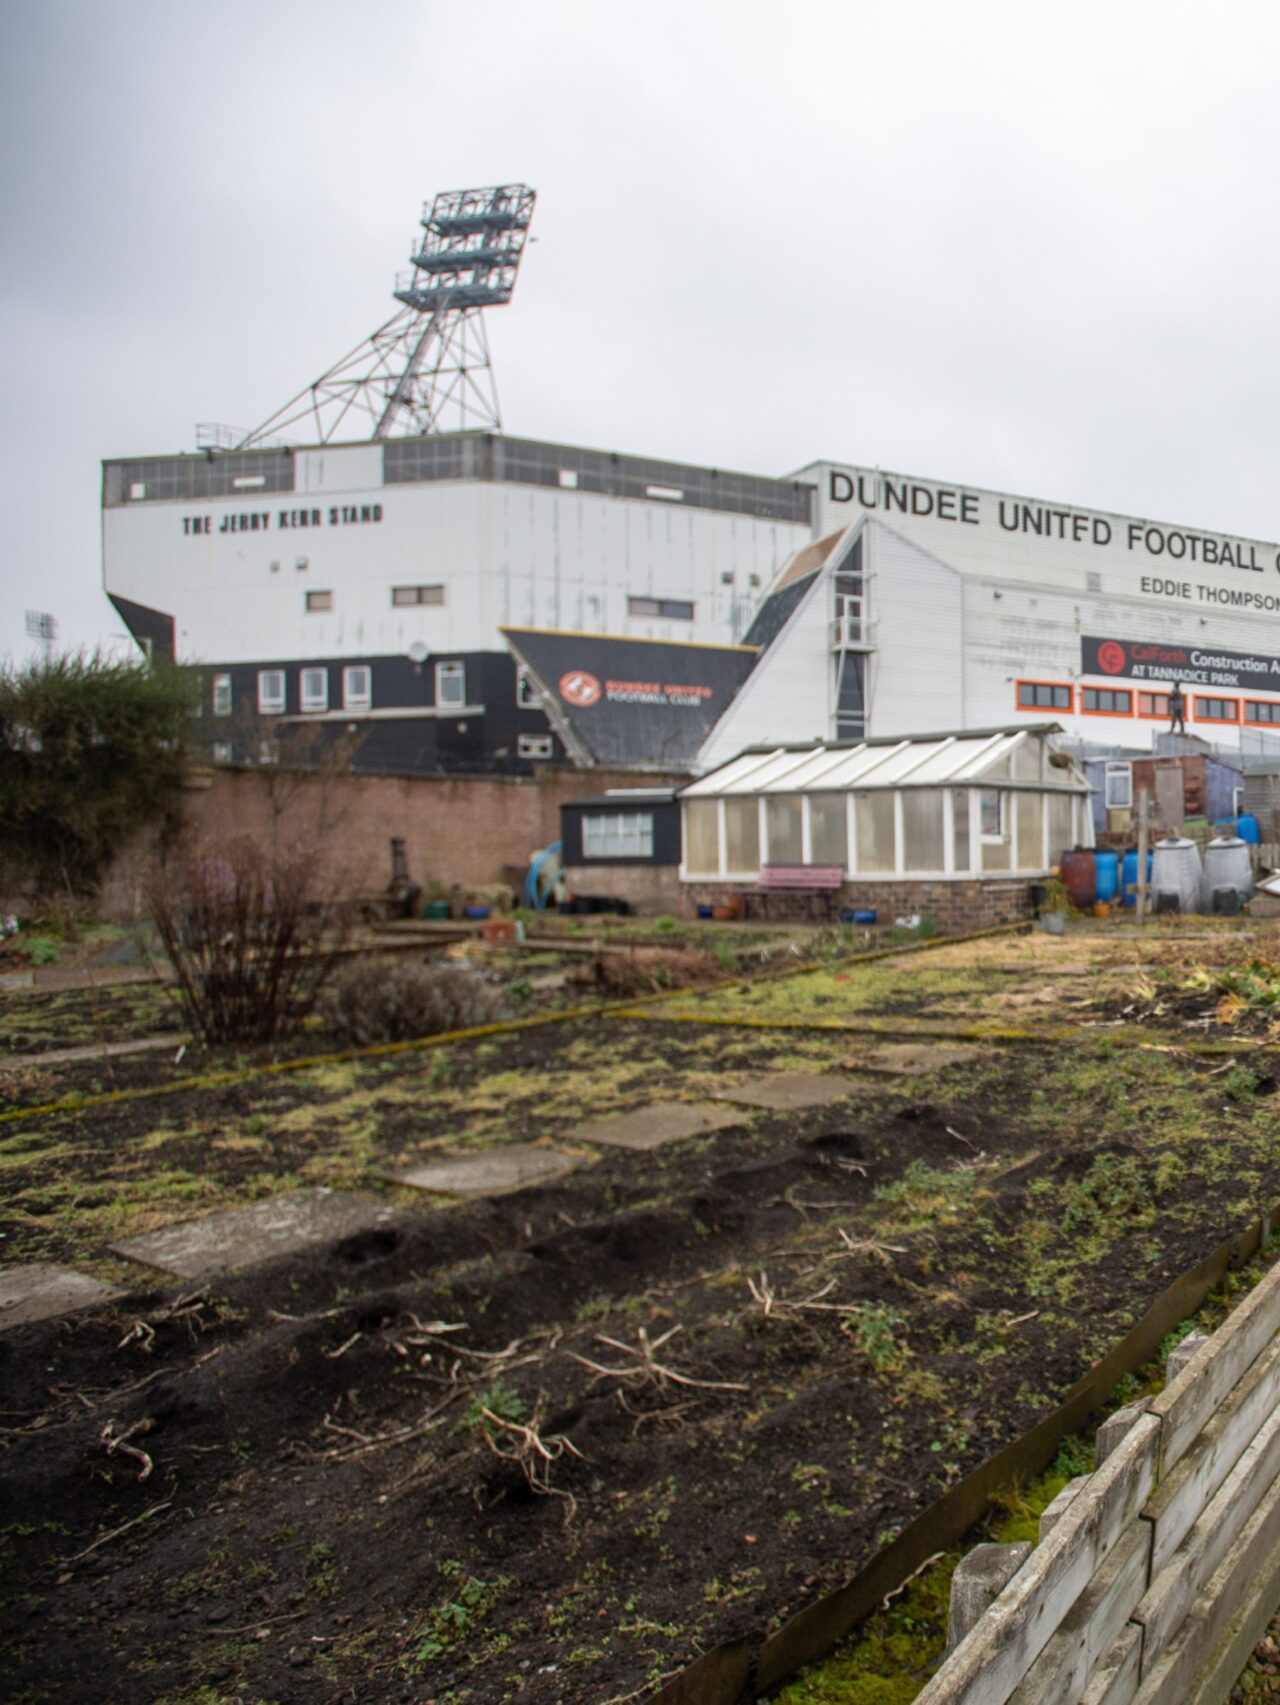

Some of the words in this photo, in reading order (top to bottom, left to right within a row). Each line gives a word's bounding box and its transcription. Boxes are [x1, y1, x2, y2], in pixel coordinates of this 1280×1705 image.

[183, 516, 210, 535] THE
[220, 513, 270, 533] JERRY
[279, 509, 321, 529] KERR
[329, 503, 383, 525] STAND
[829, 470, 980, 525] DUNDEE
[1127, 523, 1264, 572] FOOTBALL
[1140, 576, 1192, 599] EDDIE
[1131, 645, 1187, 665] CalForth
[1190, 650, 1269, 674] Construction
[1131, 664, 1145, 678] AT
[1147, 665, 1209, 684] TANNADICE
[1209, 669, 1240, 687] PARK
